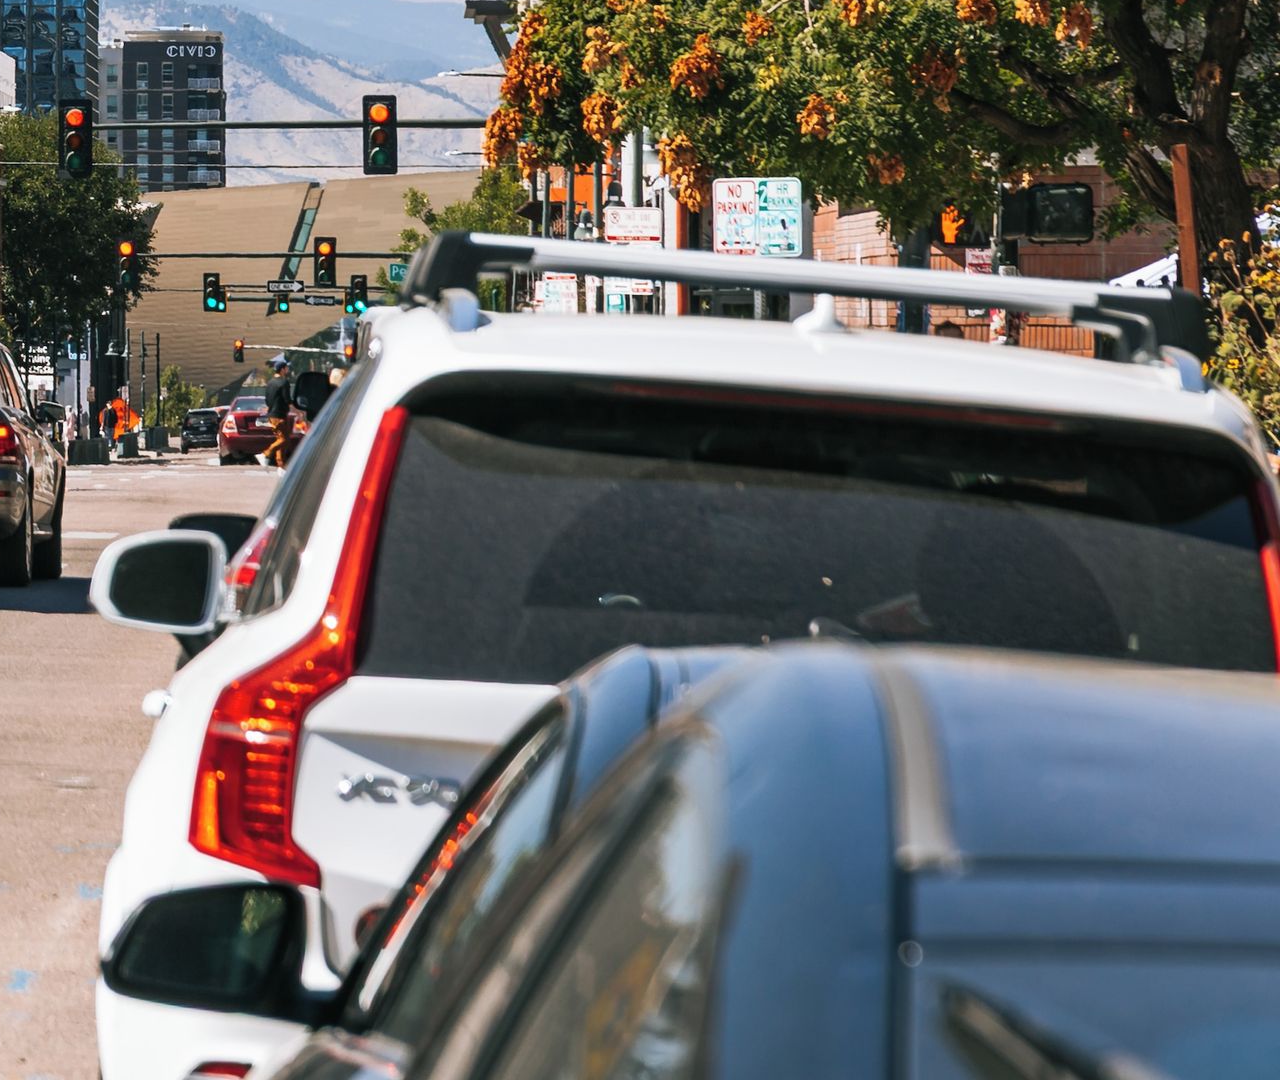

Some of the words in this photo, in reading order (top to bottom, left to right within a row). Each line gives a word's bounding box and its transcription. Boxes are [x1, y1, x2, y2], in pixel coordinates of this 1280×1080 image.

[166, 45, 216, 58] CIVIC
[727, 184, 742, 198] NO
[759, 185, 767, 206] 2
[776, 184, 789, 194] HR
[717, 201, 754, 215] PARKING
